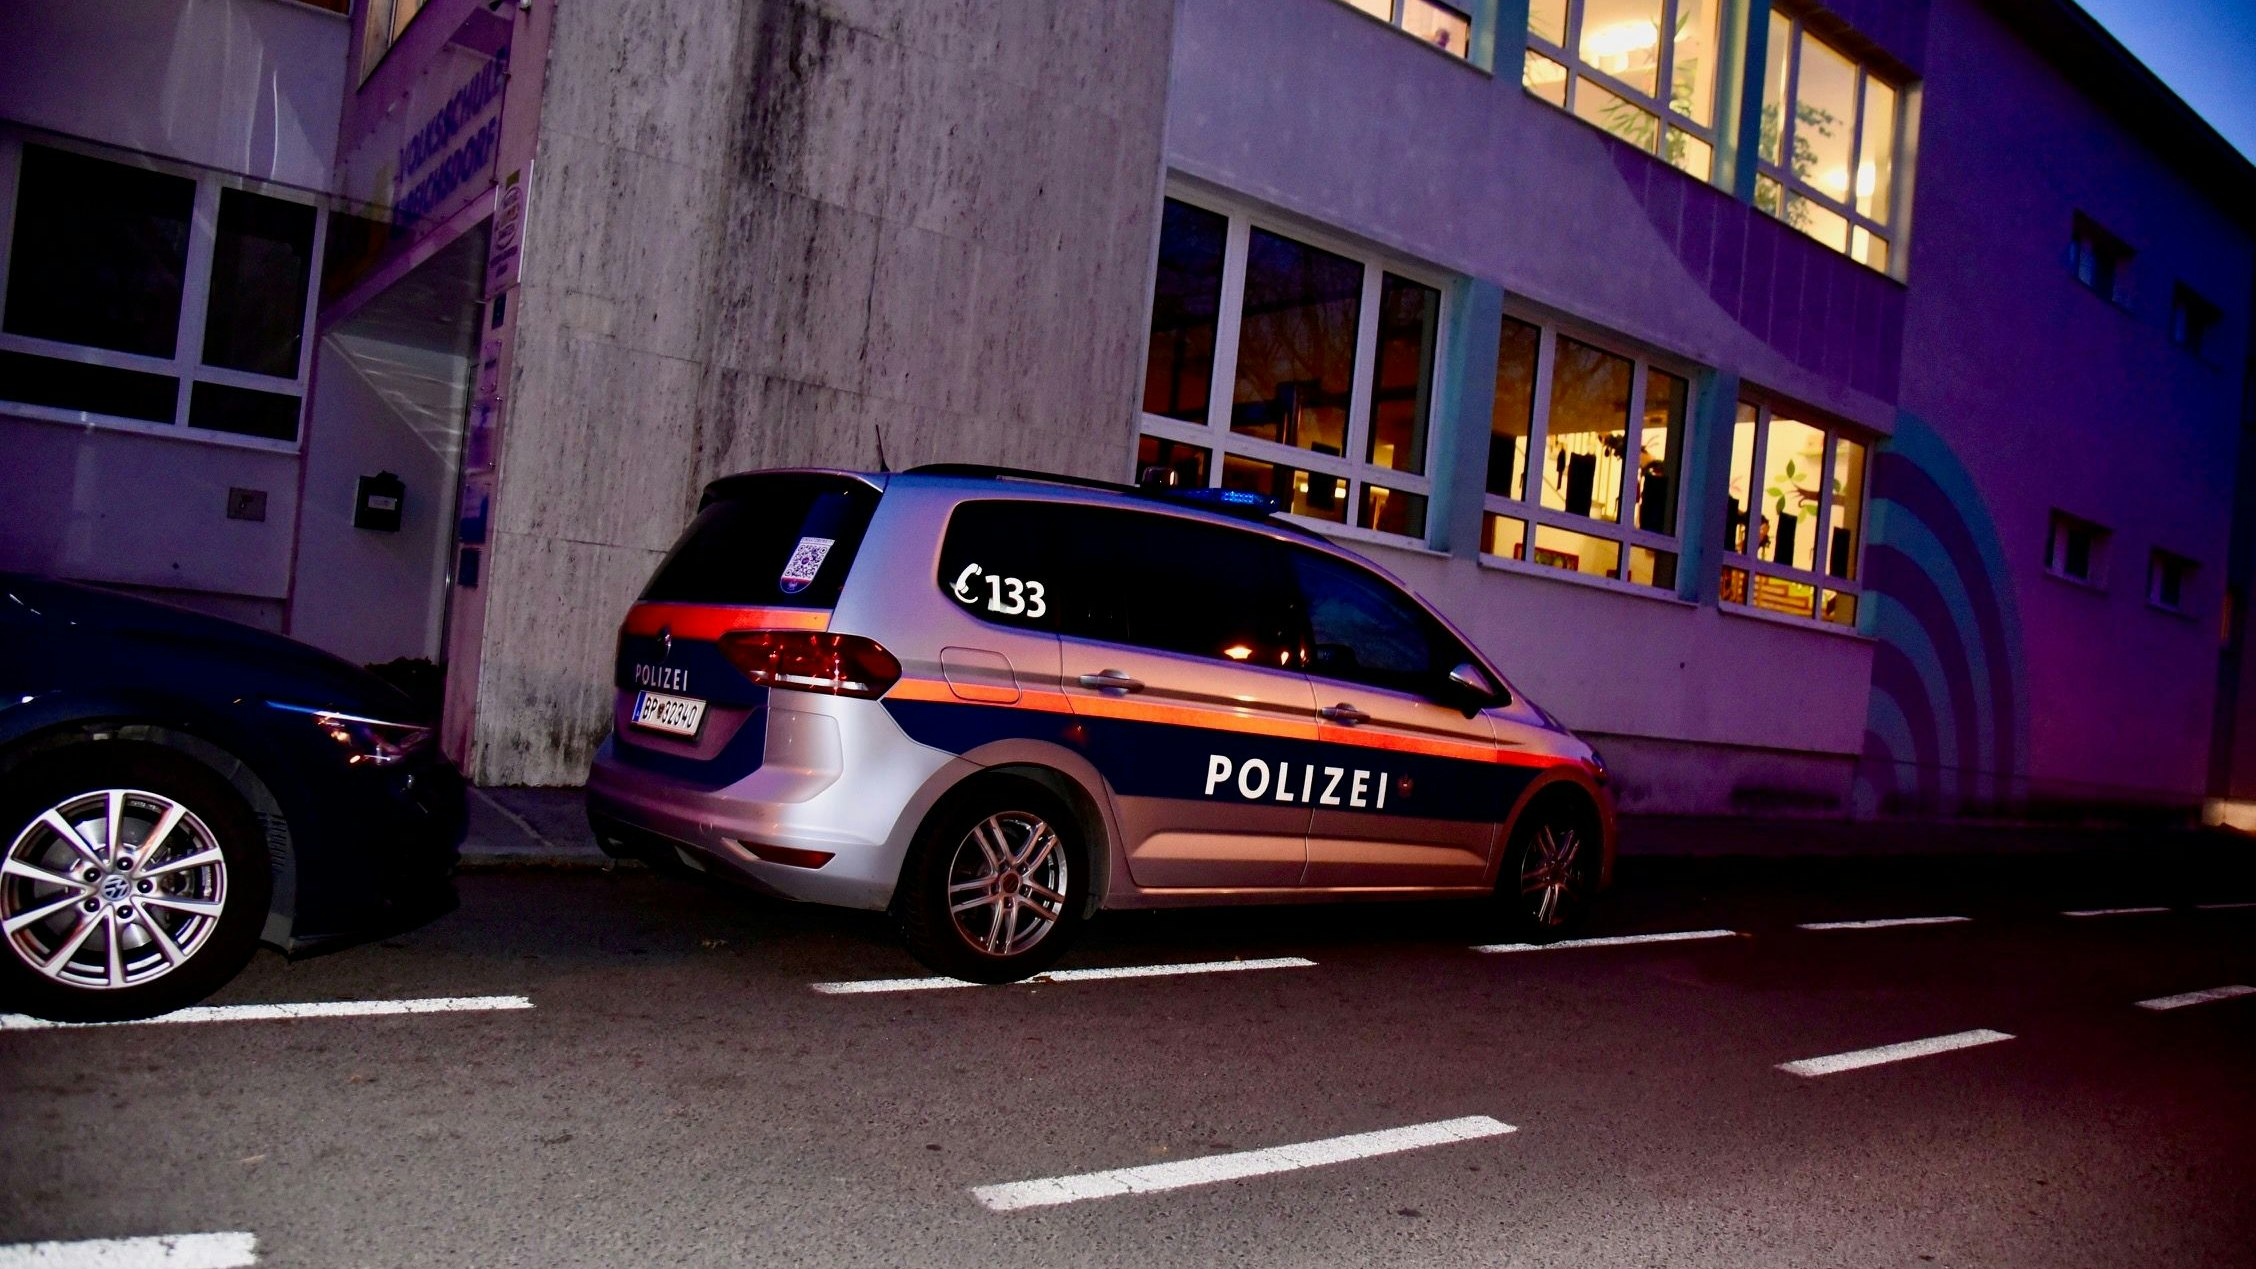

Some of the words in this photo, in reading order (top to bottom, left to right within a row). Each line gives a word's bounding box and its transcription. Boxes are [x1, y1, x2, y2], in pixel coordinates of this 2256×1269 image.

[391, 116, 497, 238] REICHSDORF
[985, 575, 1047, 618] 133
[635, 662, 689, 692] POLIZEI
[662, 700, 698, 728] 32340
[1204, 754, 1388, 810] POLIZEI
